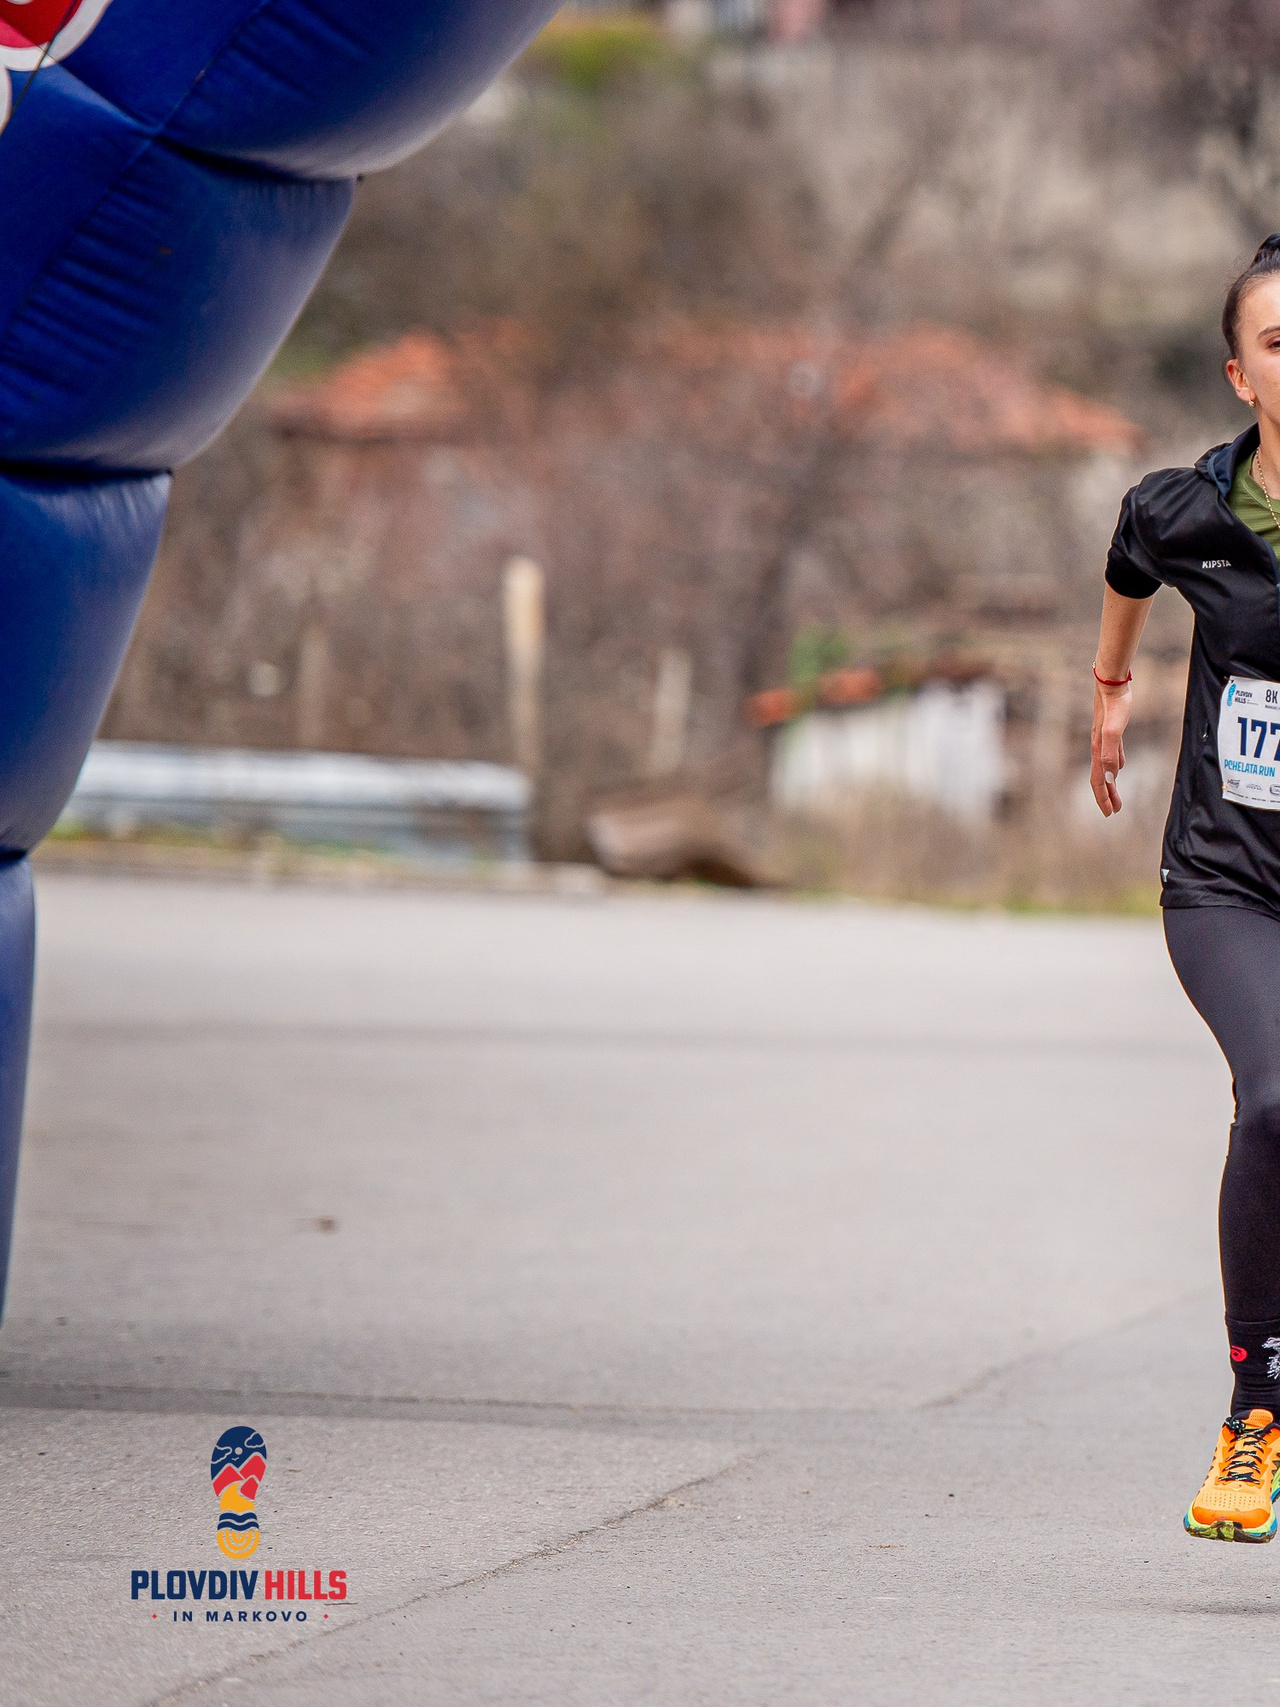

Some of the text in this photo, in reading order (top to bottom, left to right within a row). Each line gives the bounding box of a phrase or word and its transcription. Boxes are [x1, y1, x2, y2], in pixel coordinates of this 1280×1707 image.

[1202, 560, 1232, 569] KIPSTA
[1265, 689, 1279, 704] 8K
[1224, 759, 1276, 777] PCHELATA RUN
